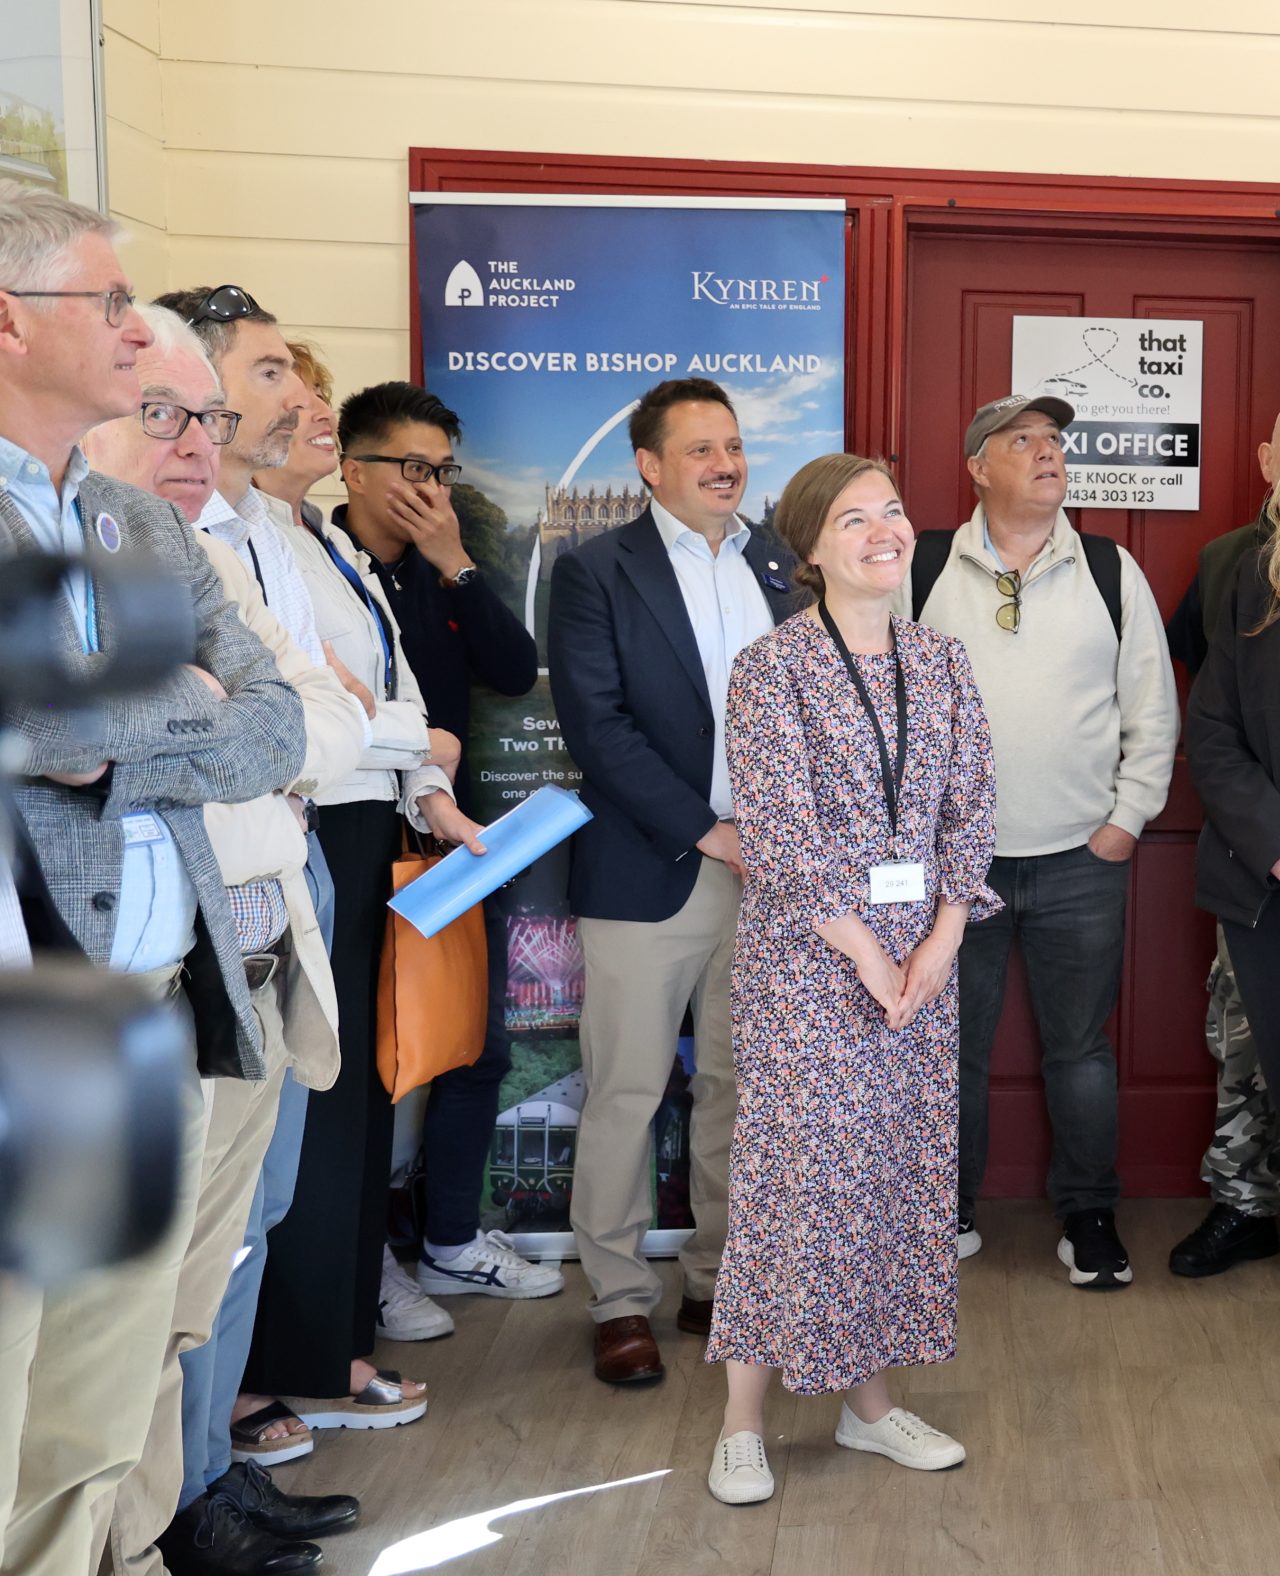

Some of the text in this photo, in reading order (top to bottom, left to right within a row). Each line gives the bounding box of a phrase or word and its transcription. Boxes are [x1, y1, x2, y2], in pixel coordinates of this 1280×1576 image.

[488, 261, 518, 273] THE
[489, 278, 576, 291] AUCKLAND
[489, 294, 559, 307] PROJECT
[1138, 329, 1187, 353] that
[448, 351, 822, 374] DISCOVER BISHOP AUCKLAND
[1138, 354, 1183, 376] taxi
[1138, 383, 1171, 399] co.
[1076, 403, 1171, 417] to get you there!
[1061, 431, 1188, 457] XI OFFICE
[1086, 472, 1137, 485] KNOCK
[1141, 477, 1156, 485] or
[1160, 473, 1183, 486] call
[1067, 489, 1154, 503] 1434 303 123
[499, 738, 539, 752] Two
[480, 770, 538, 782] Discover
[542, 769, 565, 780] the
[501, 789, 527, 799] one
